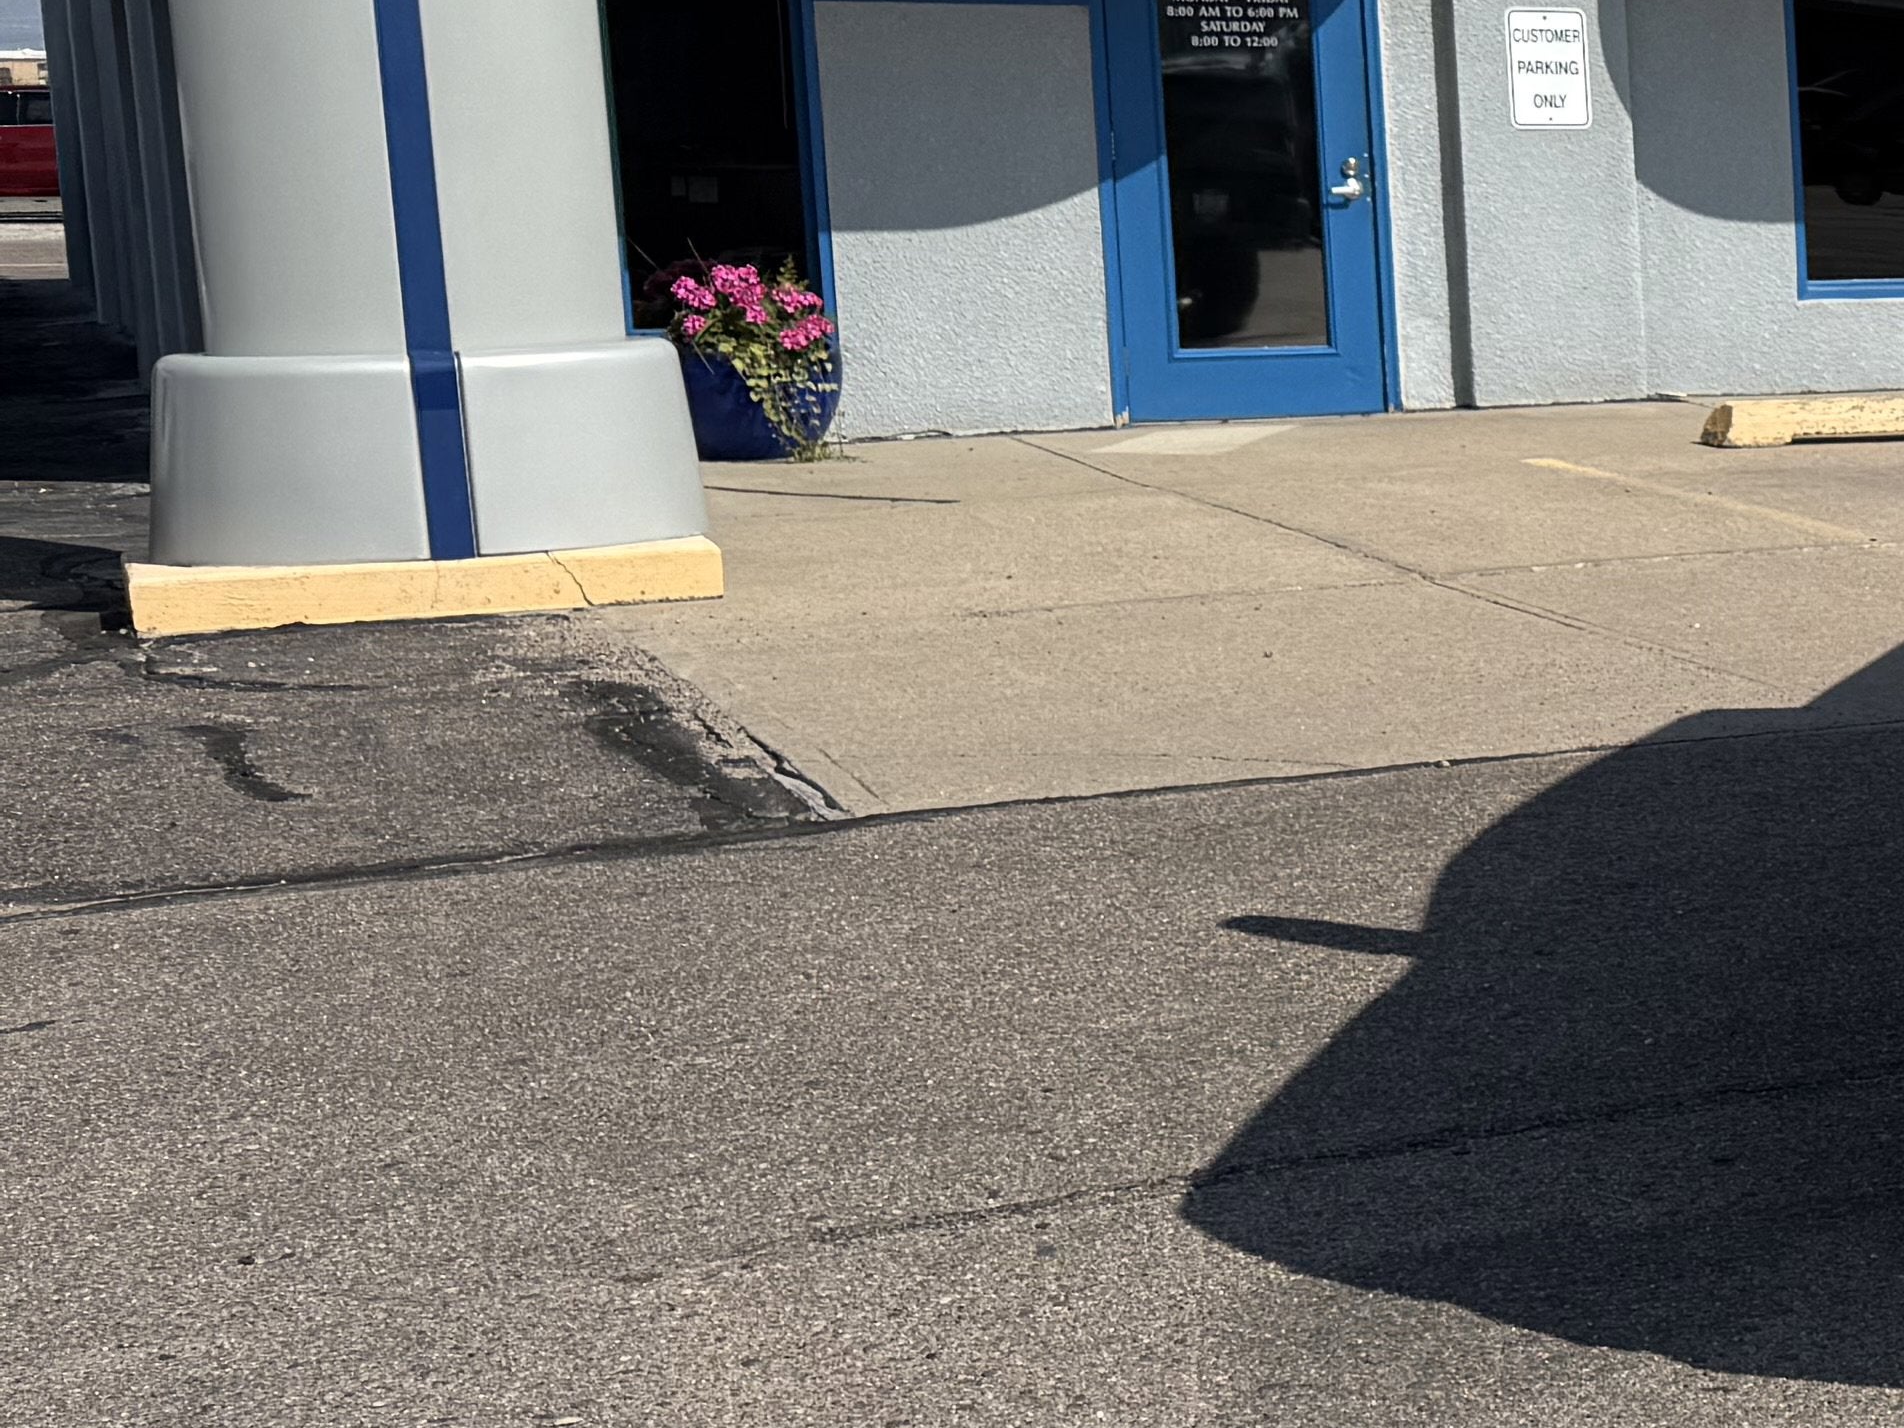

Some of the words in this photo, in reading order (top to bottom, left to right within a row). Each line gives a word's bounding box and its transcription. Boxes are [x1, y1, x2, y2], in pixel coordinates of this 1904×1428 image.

[1166, 6, 1194, 17] 8:00
[1198, 6, 1221, 18] AM
[1225, 7, 1243, 18] TO
[1247, 8, 1274, 18] 6:00
[1278, 8, 1299, 19] PM
[1200, 20, 1266, 33] SATURDAY
[1191, 36, 1219, 47] 8:00
[1223, 36, 1242, 47] TO
[1246, 36, 1278, 47] 12:00
[1513, 28, 1580, 43] CUSTOMER
[1518, 60, 1579, 75] PARKING
[1533, 94, 1567, 109] ONLY
